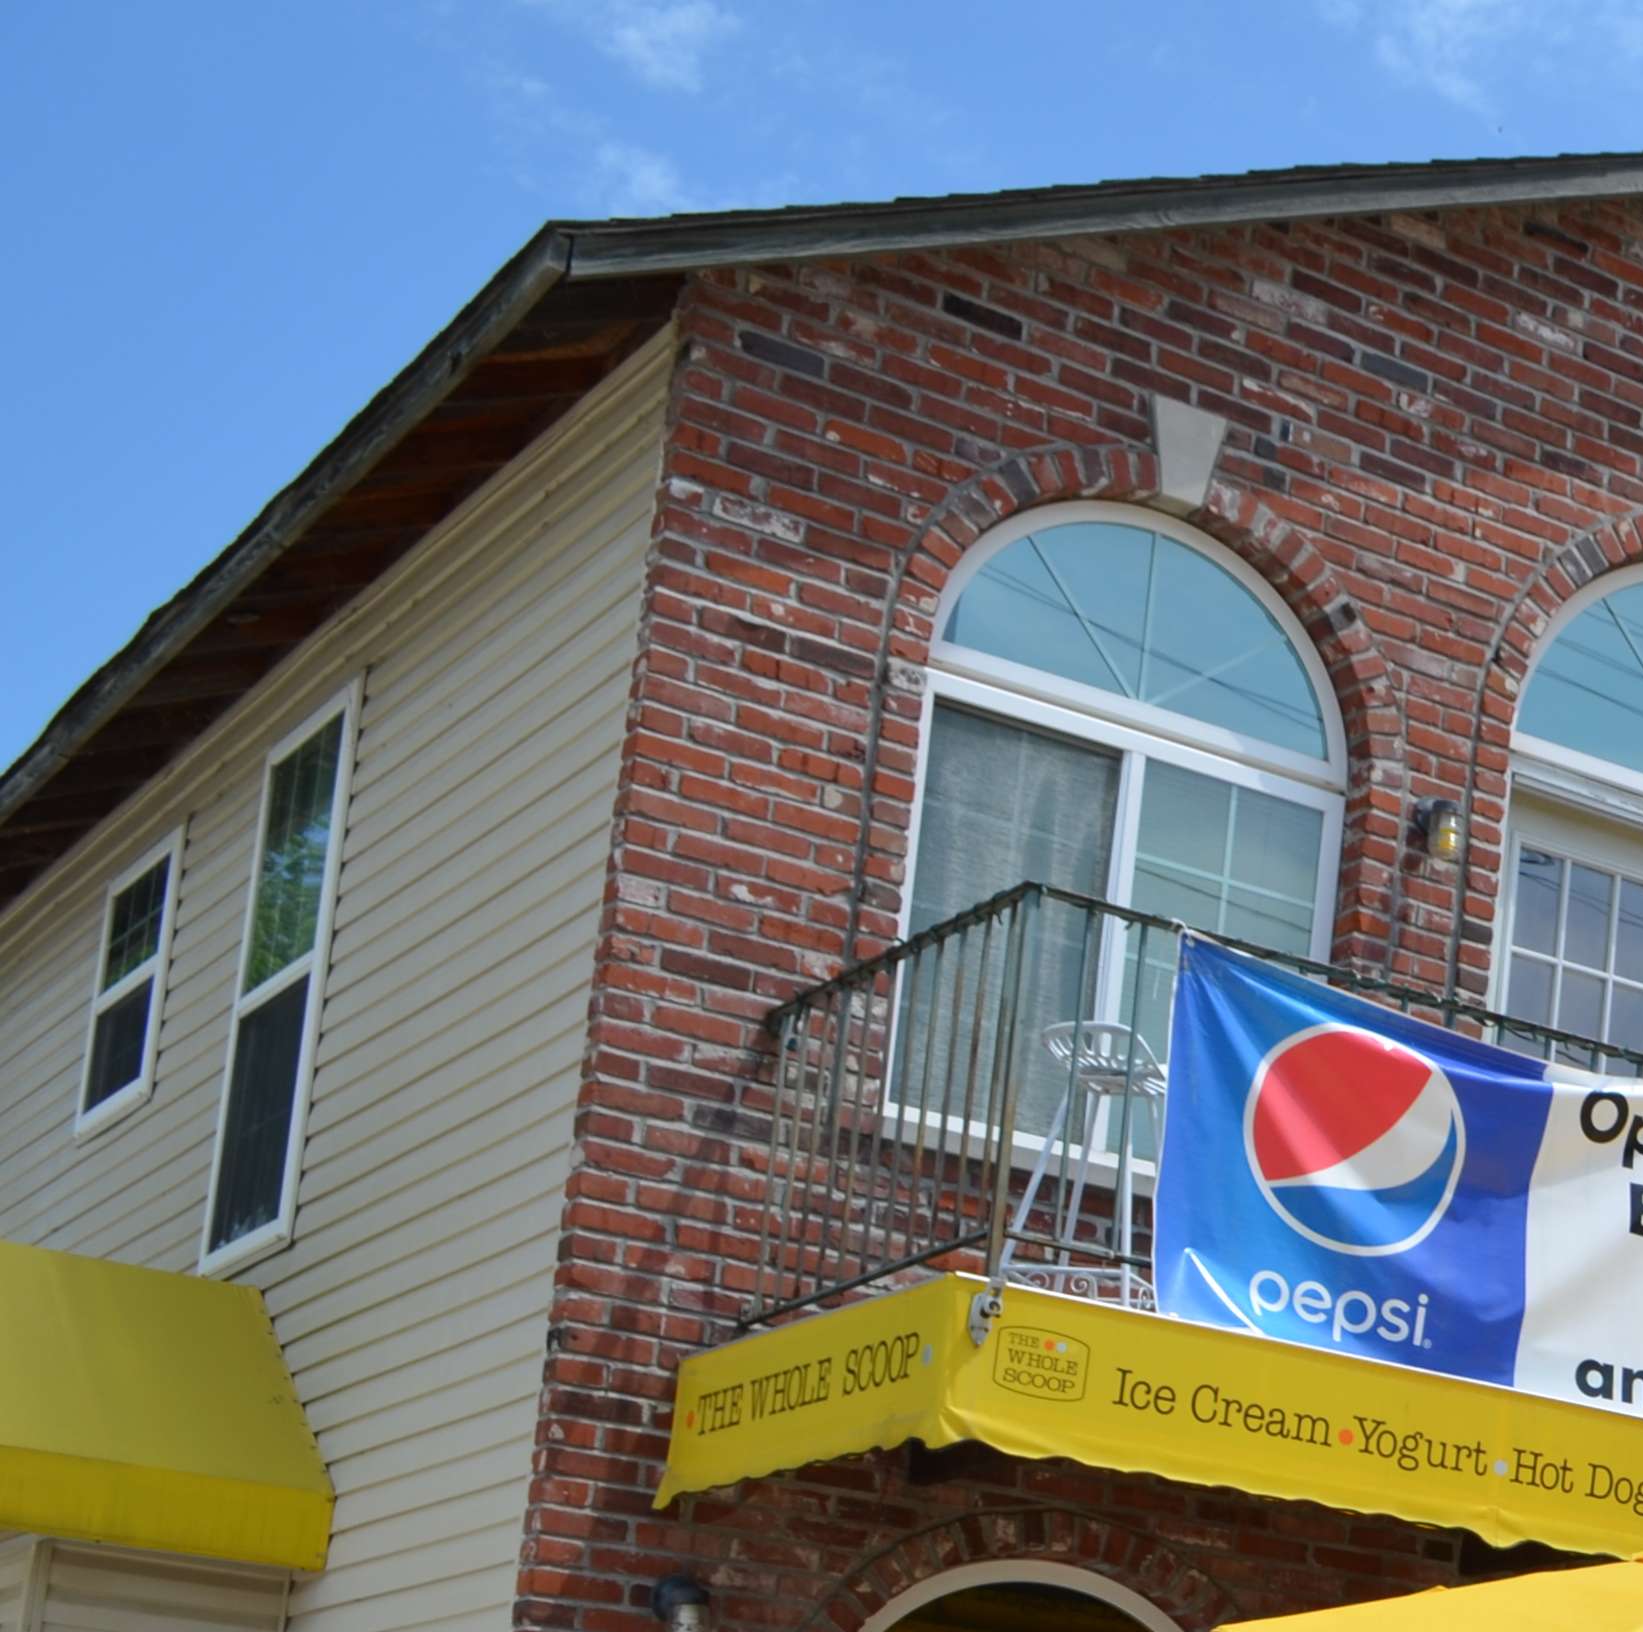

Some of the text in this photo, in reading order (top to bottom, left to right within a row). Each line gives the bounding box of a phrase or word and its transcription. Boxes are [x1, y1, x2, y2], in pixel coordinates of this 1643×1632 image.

[1249, 1270, 1428, 1348] pepsi
[1008, 1332, 1040, 1348] THE
[1008, 1348, 1078, 1376] WHOLE
[697, 1332, 921, 1436] THE WHOLE SCOOP
[1003, 1367, 1075, 1393] SCOOP
[1113, 1368, 1176, 1415] Ice
[1191, 1384, 1333, 1448] Cream
[1353, 1416, 1488, 1477] Yogurt
[1510, 1449, 1574, 1493] Hot
